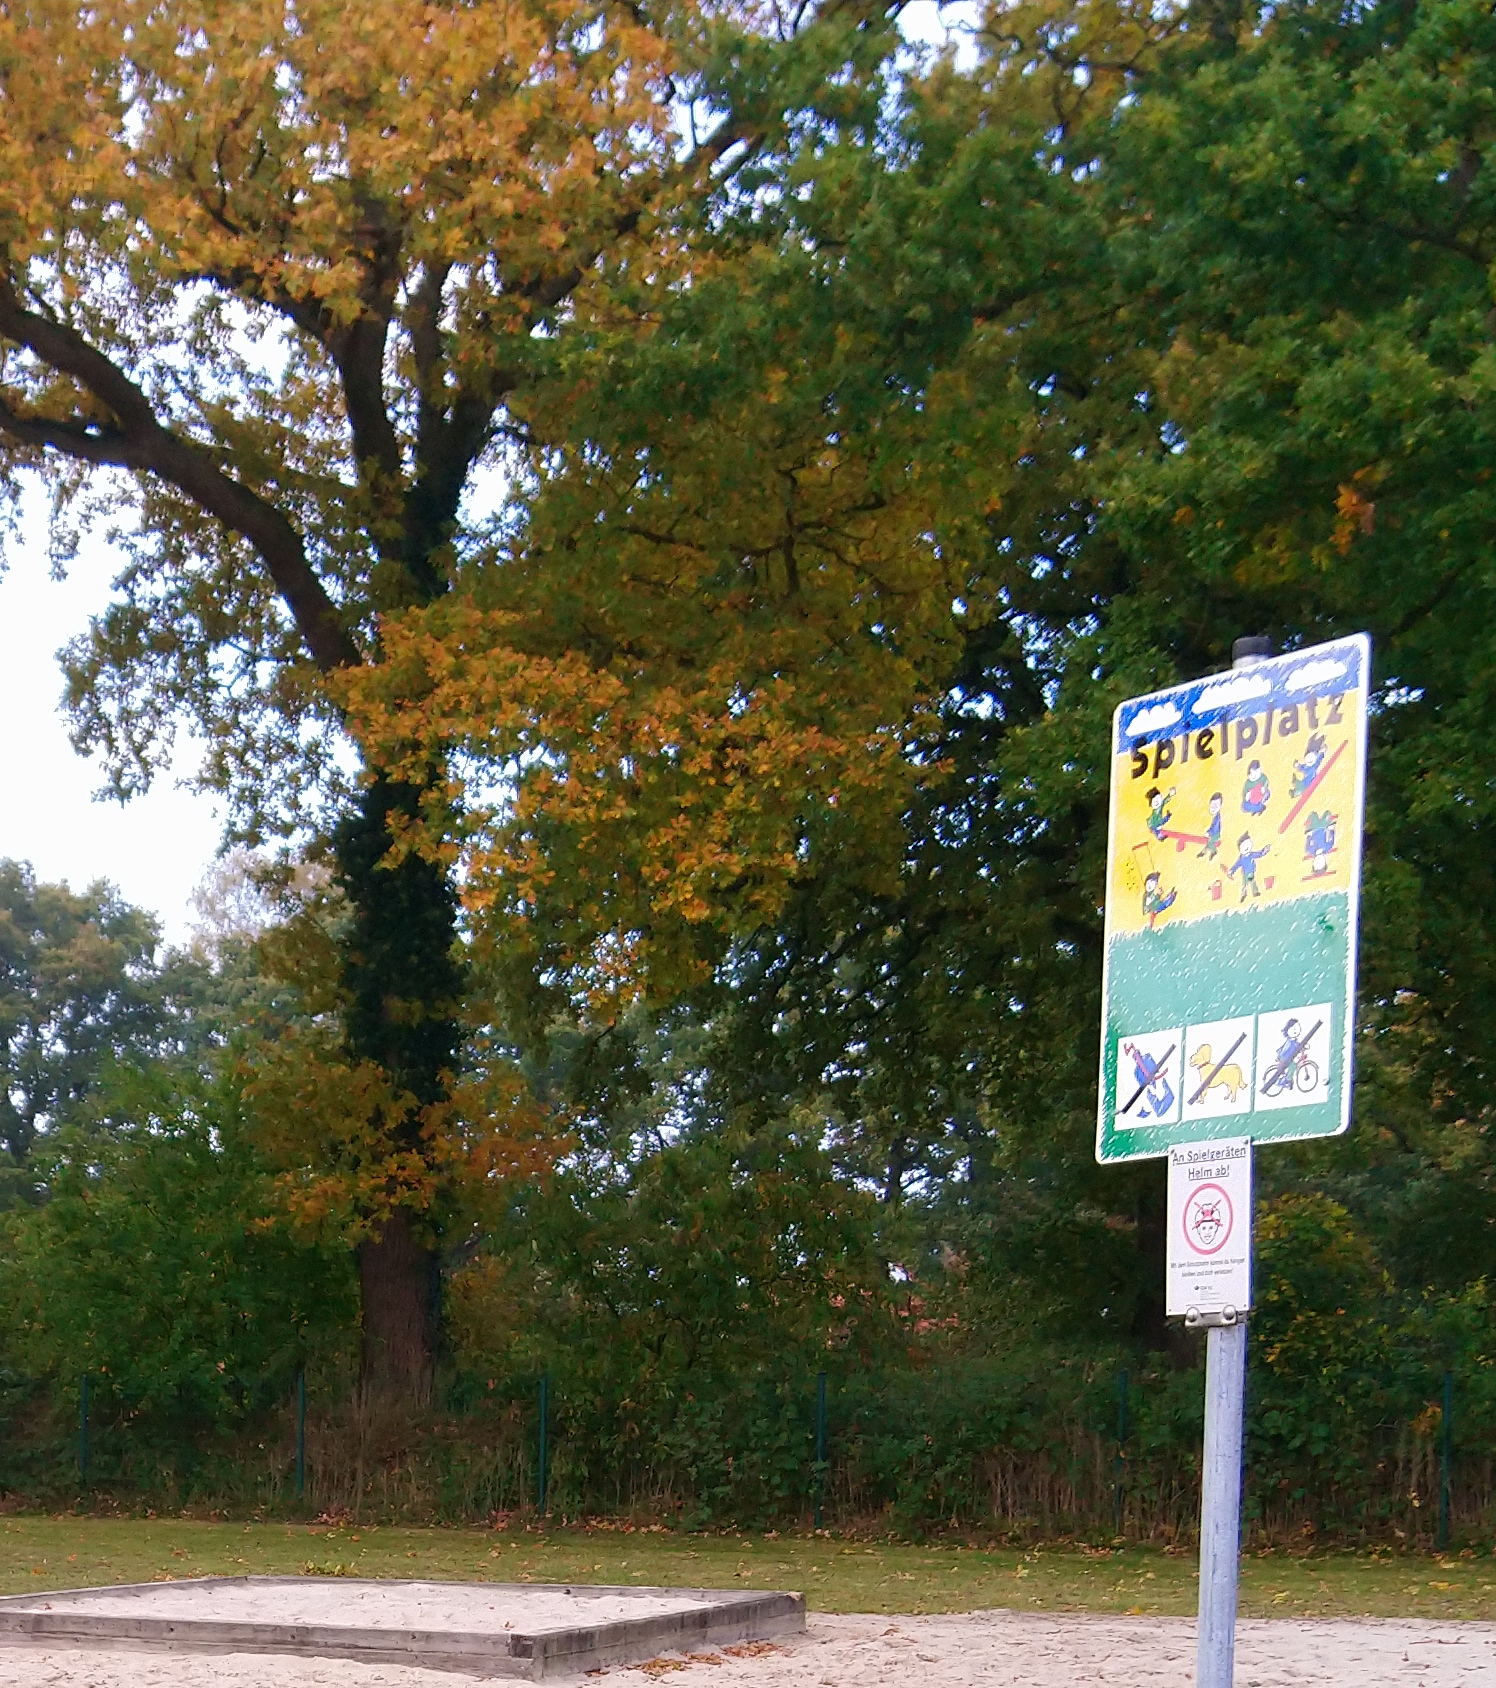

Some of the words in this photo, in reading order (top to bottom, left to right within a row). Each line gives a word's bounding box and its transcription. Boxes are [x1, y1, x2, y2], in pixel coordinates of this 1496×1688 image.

[1131, 692, 1346, 780] Spielplatz
[1173, 1152, 1185, 1163] An
[1187, 1146, 1246, 1162] Spielgeräten
[1188, 1167, 1212, 1178] Helm
[1215, 1165, 1229, 1177] ab!
